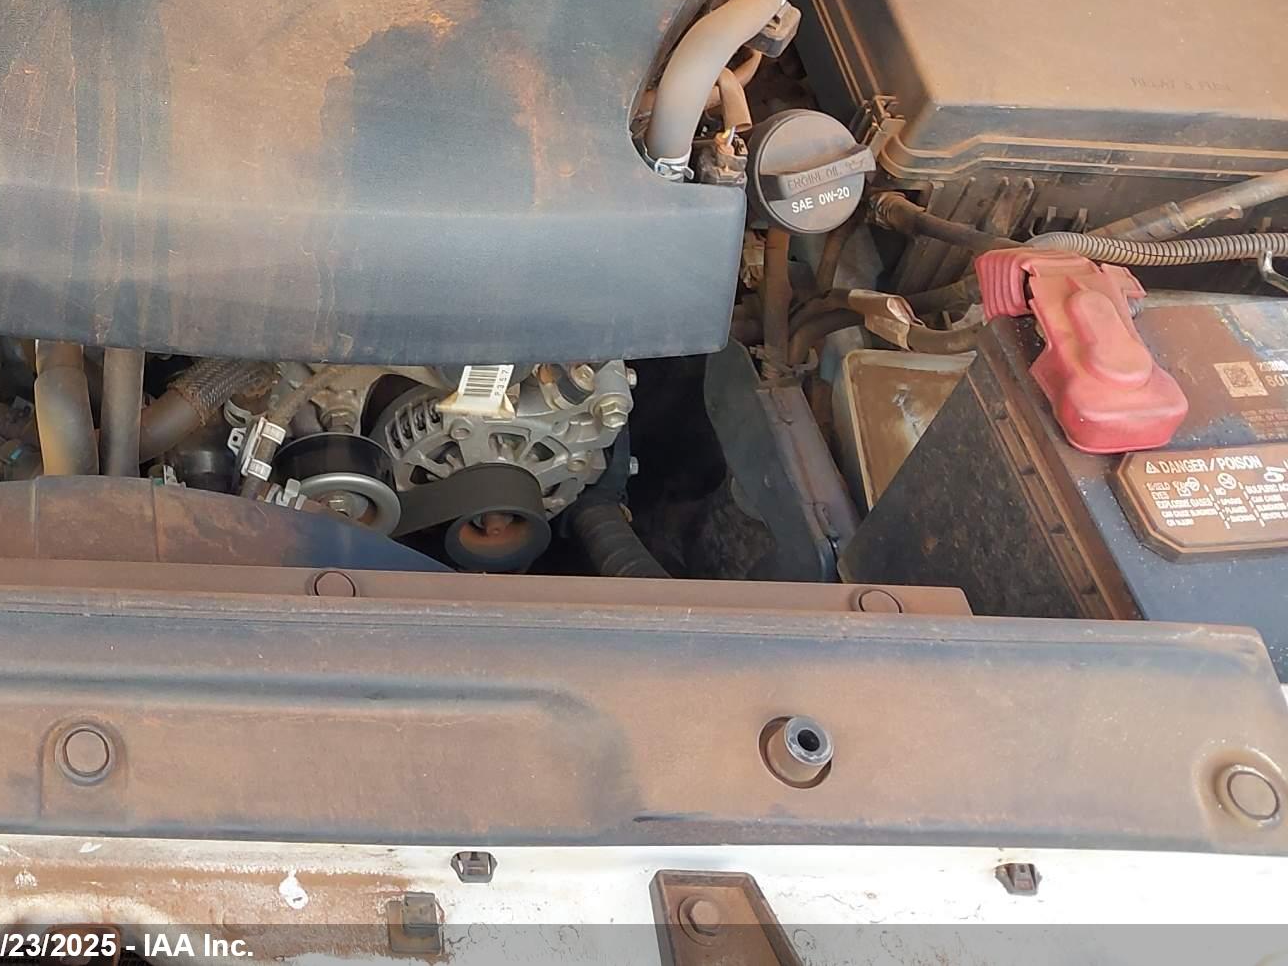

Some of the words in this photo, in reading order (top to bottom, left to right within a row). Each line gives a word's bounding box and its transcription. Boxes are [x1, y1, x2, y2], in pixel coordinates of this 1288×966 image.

[791, 197, 814, 214] SAE
[818, 186, 850, 205] 0W-20
[1158, 459, 1208, 474] DANGER
[1209, 458, 1215, 471] /
[1216, 455, 1263, 471] POISON
